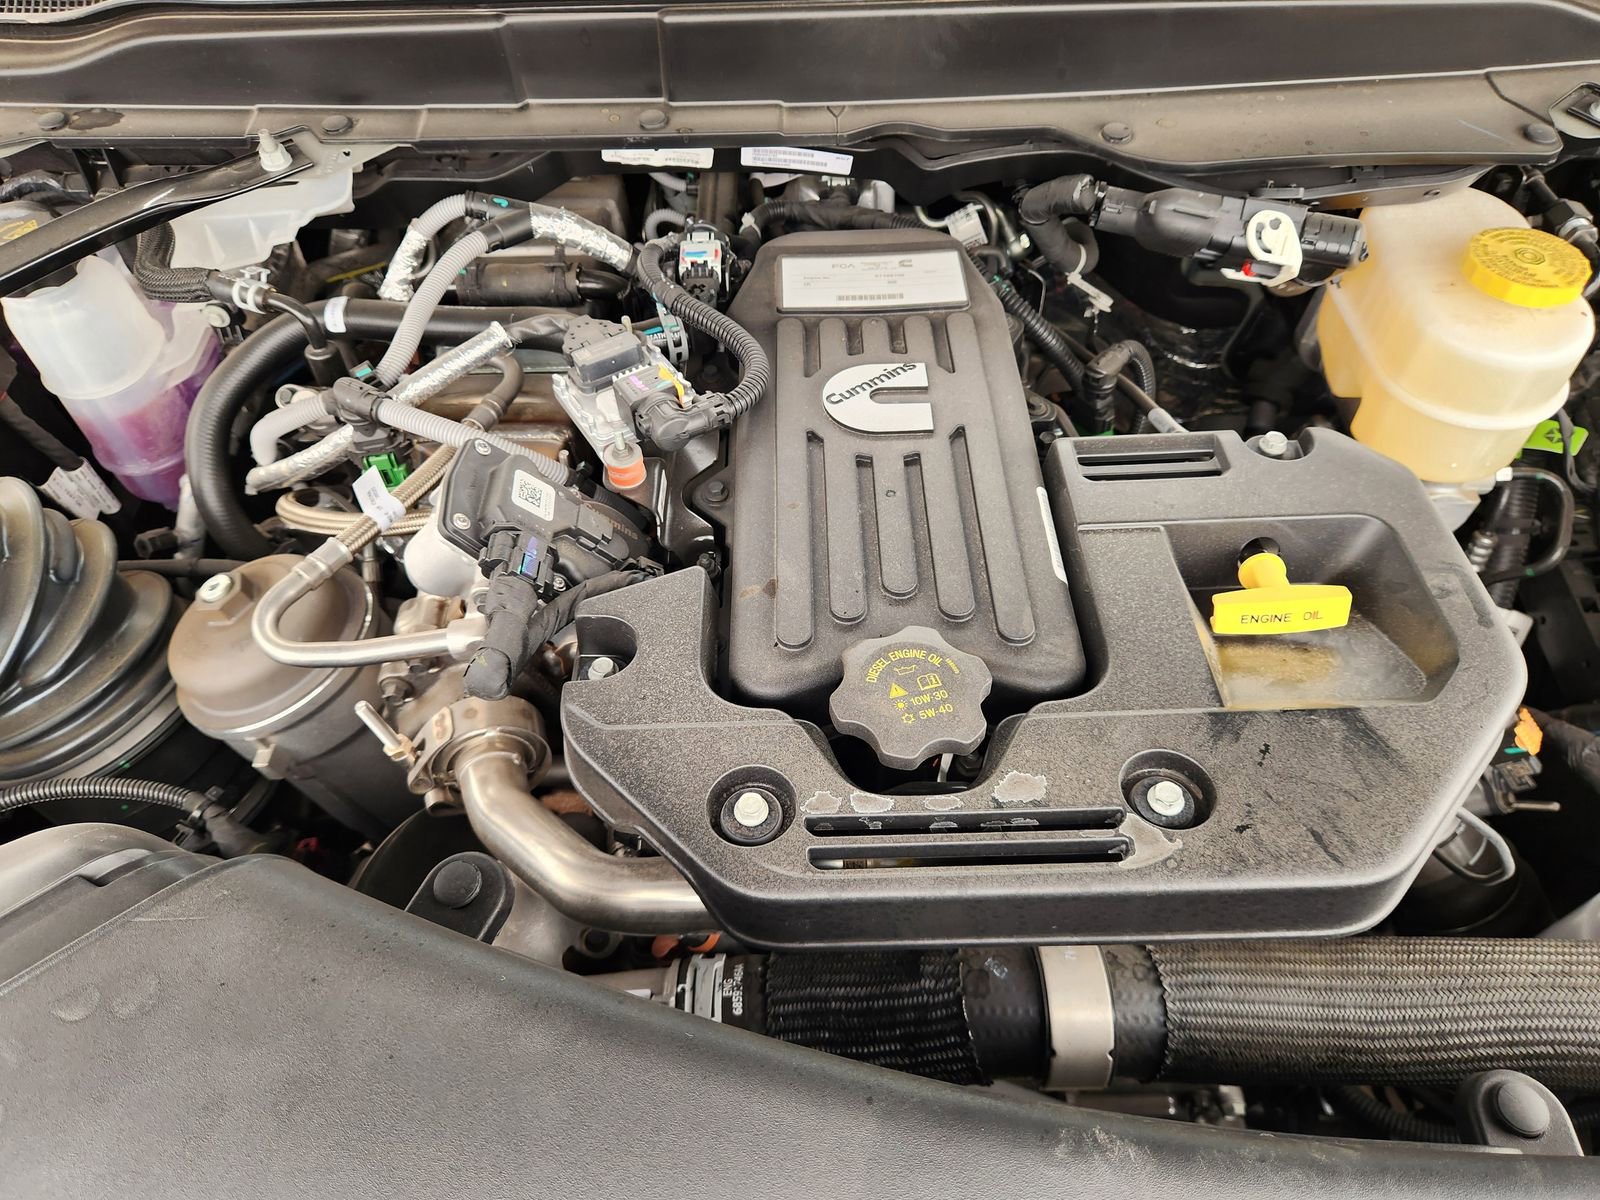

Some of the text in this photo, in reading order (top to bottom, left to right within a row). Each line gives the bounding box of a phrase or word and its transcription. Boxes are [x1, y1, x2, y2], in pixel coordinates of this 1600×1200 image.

[825, 362, 917, 405] Cummins
[1240, 610, 1323, 625] ENGINE OIL
[866, 657, 891, 683] DIESEL
[888, 648, 927, 662] ENGINE
[927, 653, 943, 667] OIL
[911, 689, 949, 706] 10W-30
[919, 703, 954, 719] 5W-40
[723, 978, 733, 997] ENG
